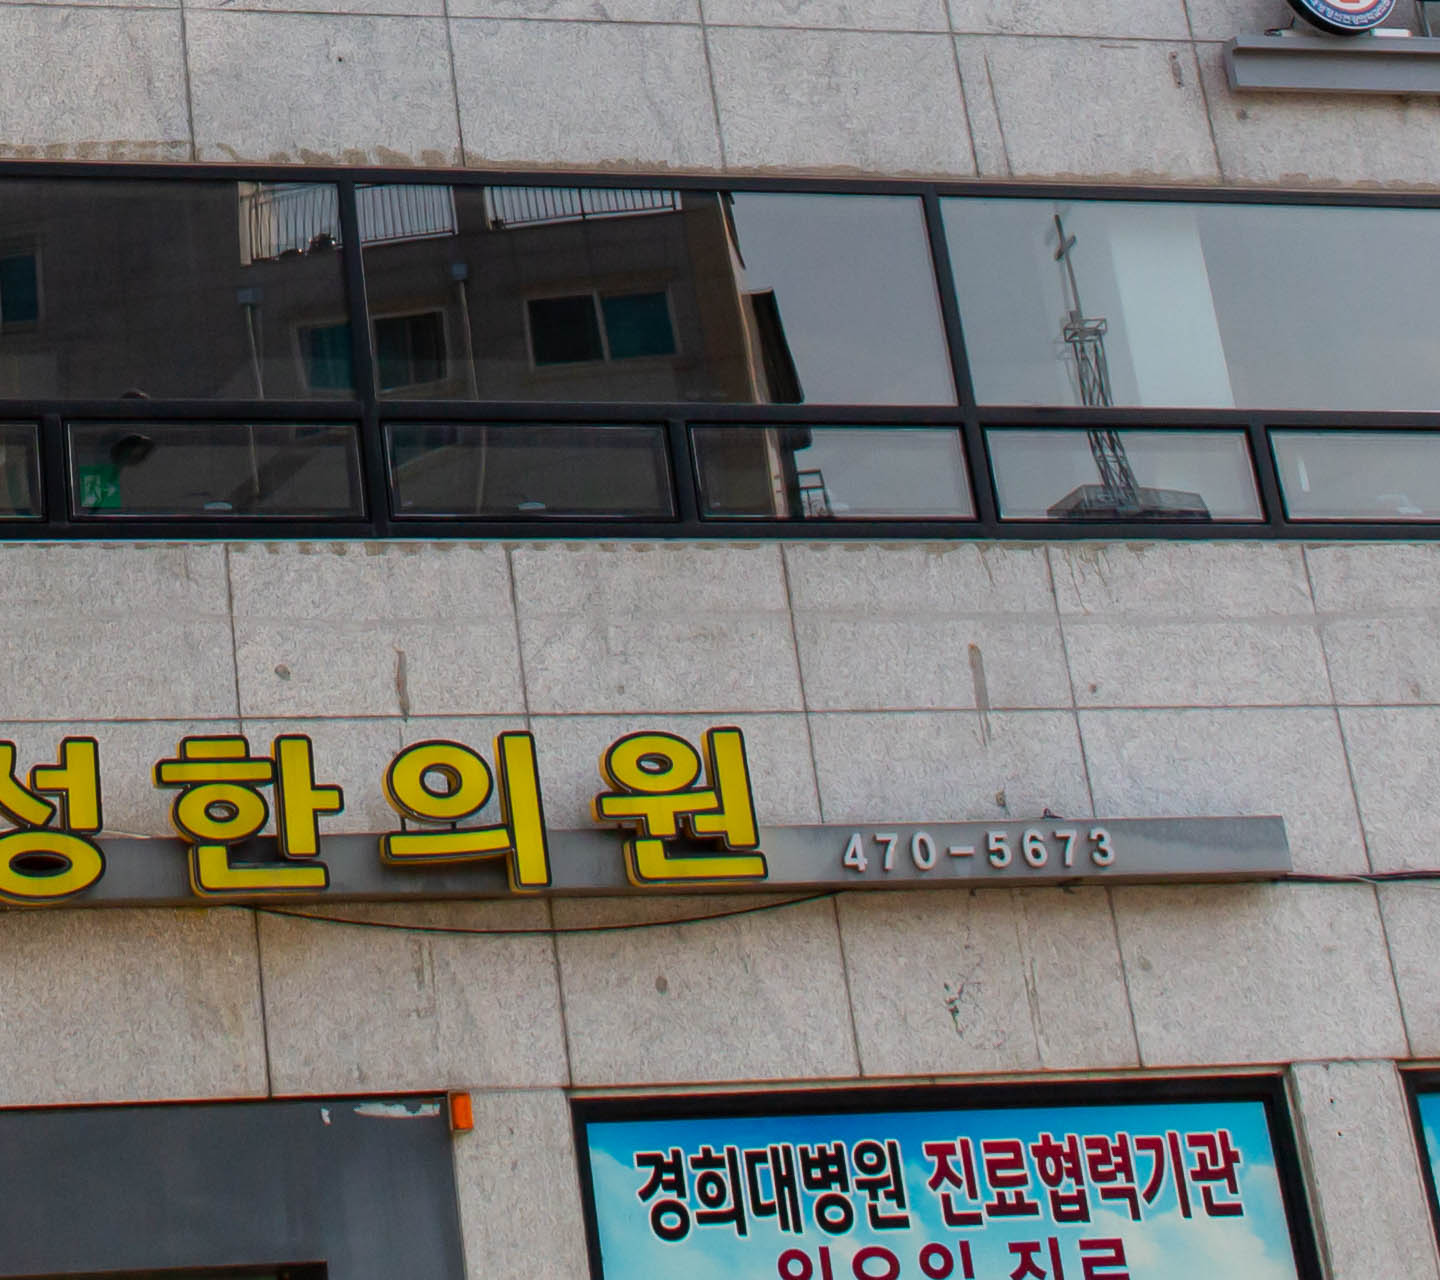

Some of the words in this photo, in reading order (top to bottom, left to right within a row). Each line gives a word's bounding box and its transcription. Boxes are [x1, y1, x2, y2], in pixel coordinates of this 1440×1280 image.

[842, 826, 1116, 873] 470-5673
[635, 1138, 911, 1244] 경희대병원
[922, 1130, 1245, 1229] 진료협력기관
